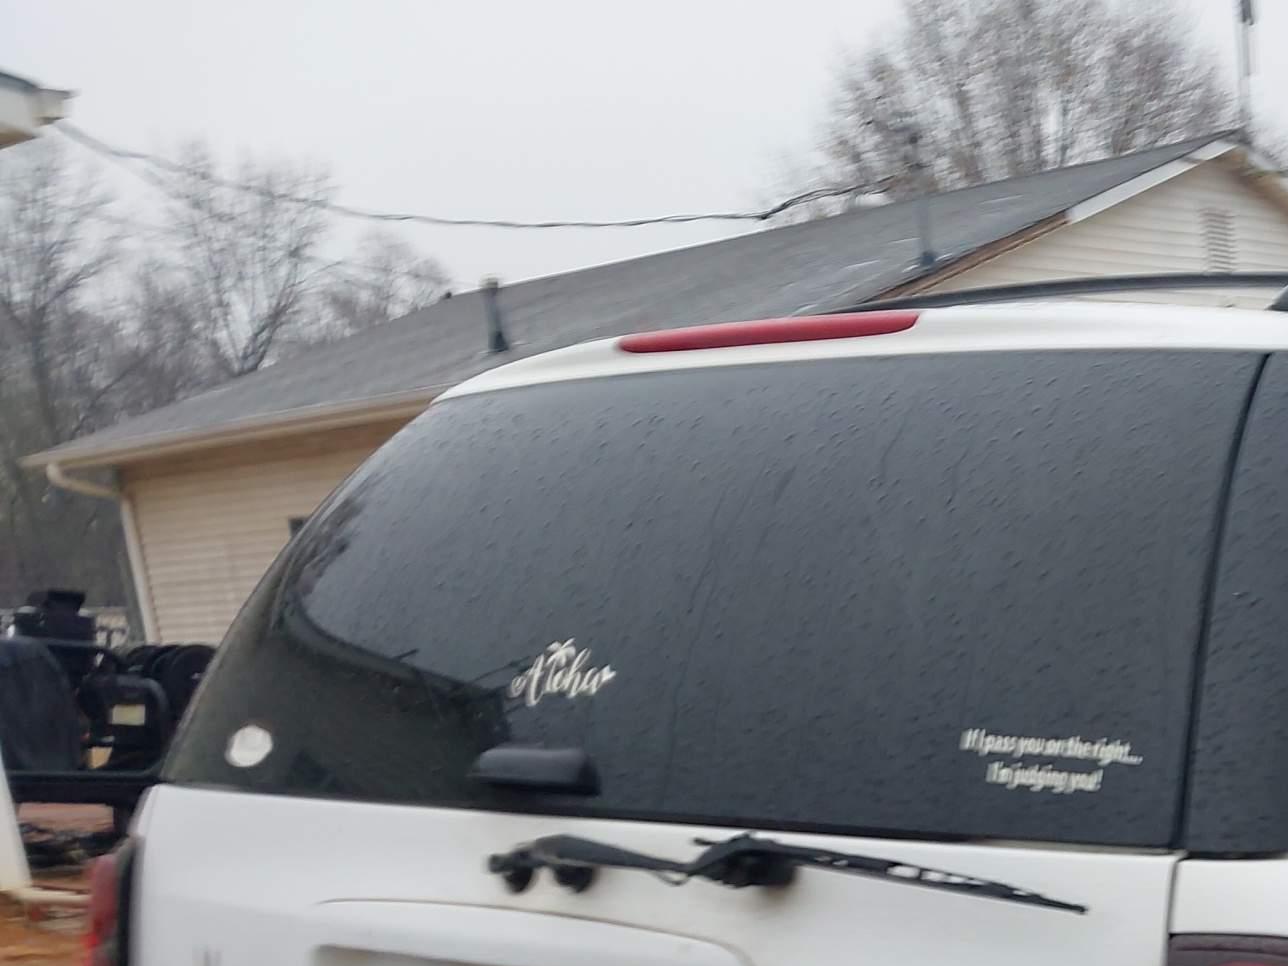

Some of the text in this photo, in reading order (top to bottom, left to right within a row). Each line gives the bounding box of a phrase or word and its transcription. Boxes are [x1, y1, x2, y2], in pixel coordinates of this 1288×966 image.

[506, 638, 616, 707] Aloha
[979, 735, 1017, 757] pass
[1012, 736, 1046, 758] you
[1045, 738, 1063, 757] on
[1061, 735, 1093, 760] the
[1006, 762, 1070, 793] judging
